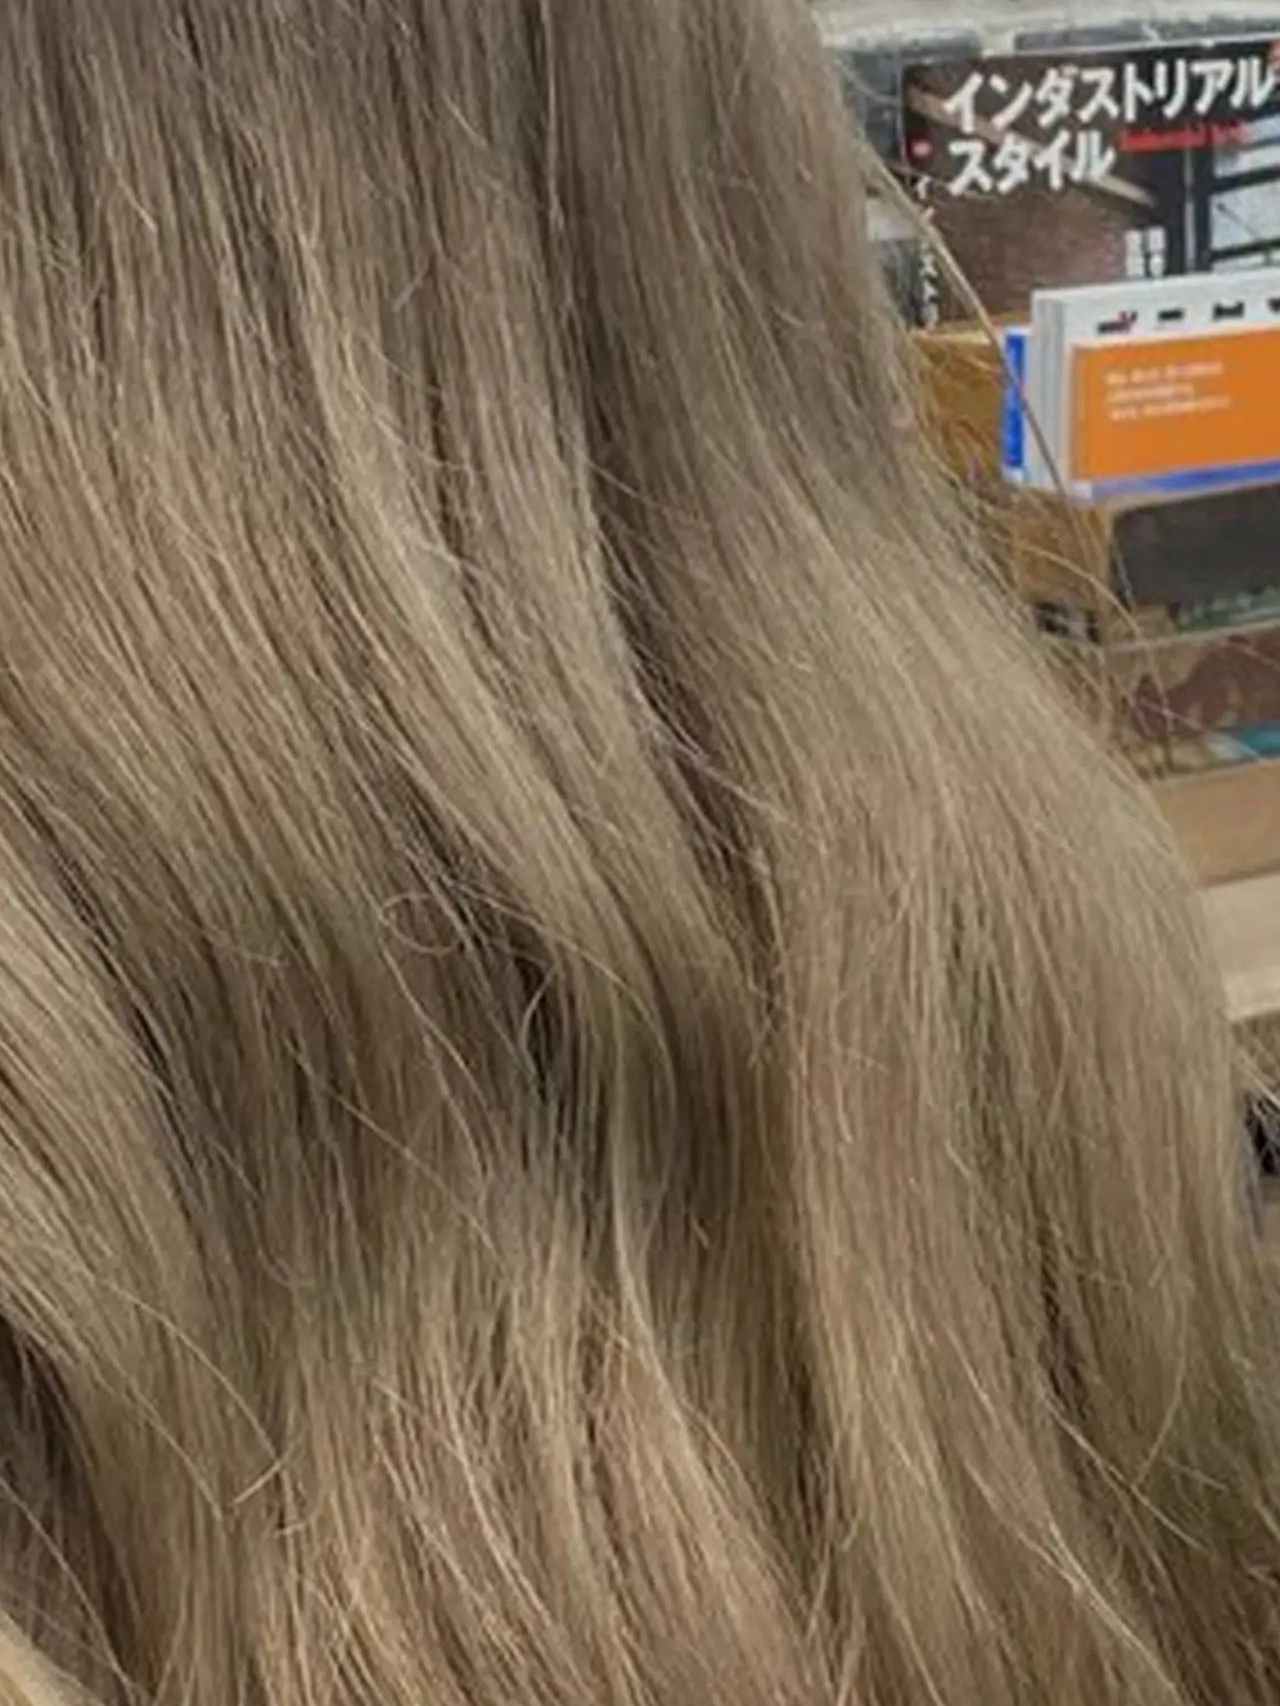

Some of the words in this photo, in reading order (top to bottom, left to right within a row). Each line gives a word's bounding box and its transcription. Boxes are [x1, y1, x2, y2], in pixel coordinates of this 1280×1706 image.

[943, 57, 1275, 134] インダストリアル
[948, 129, 1117, 196] スタイル
